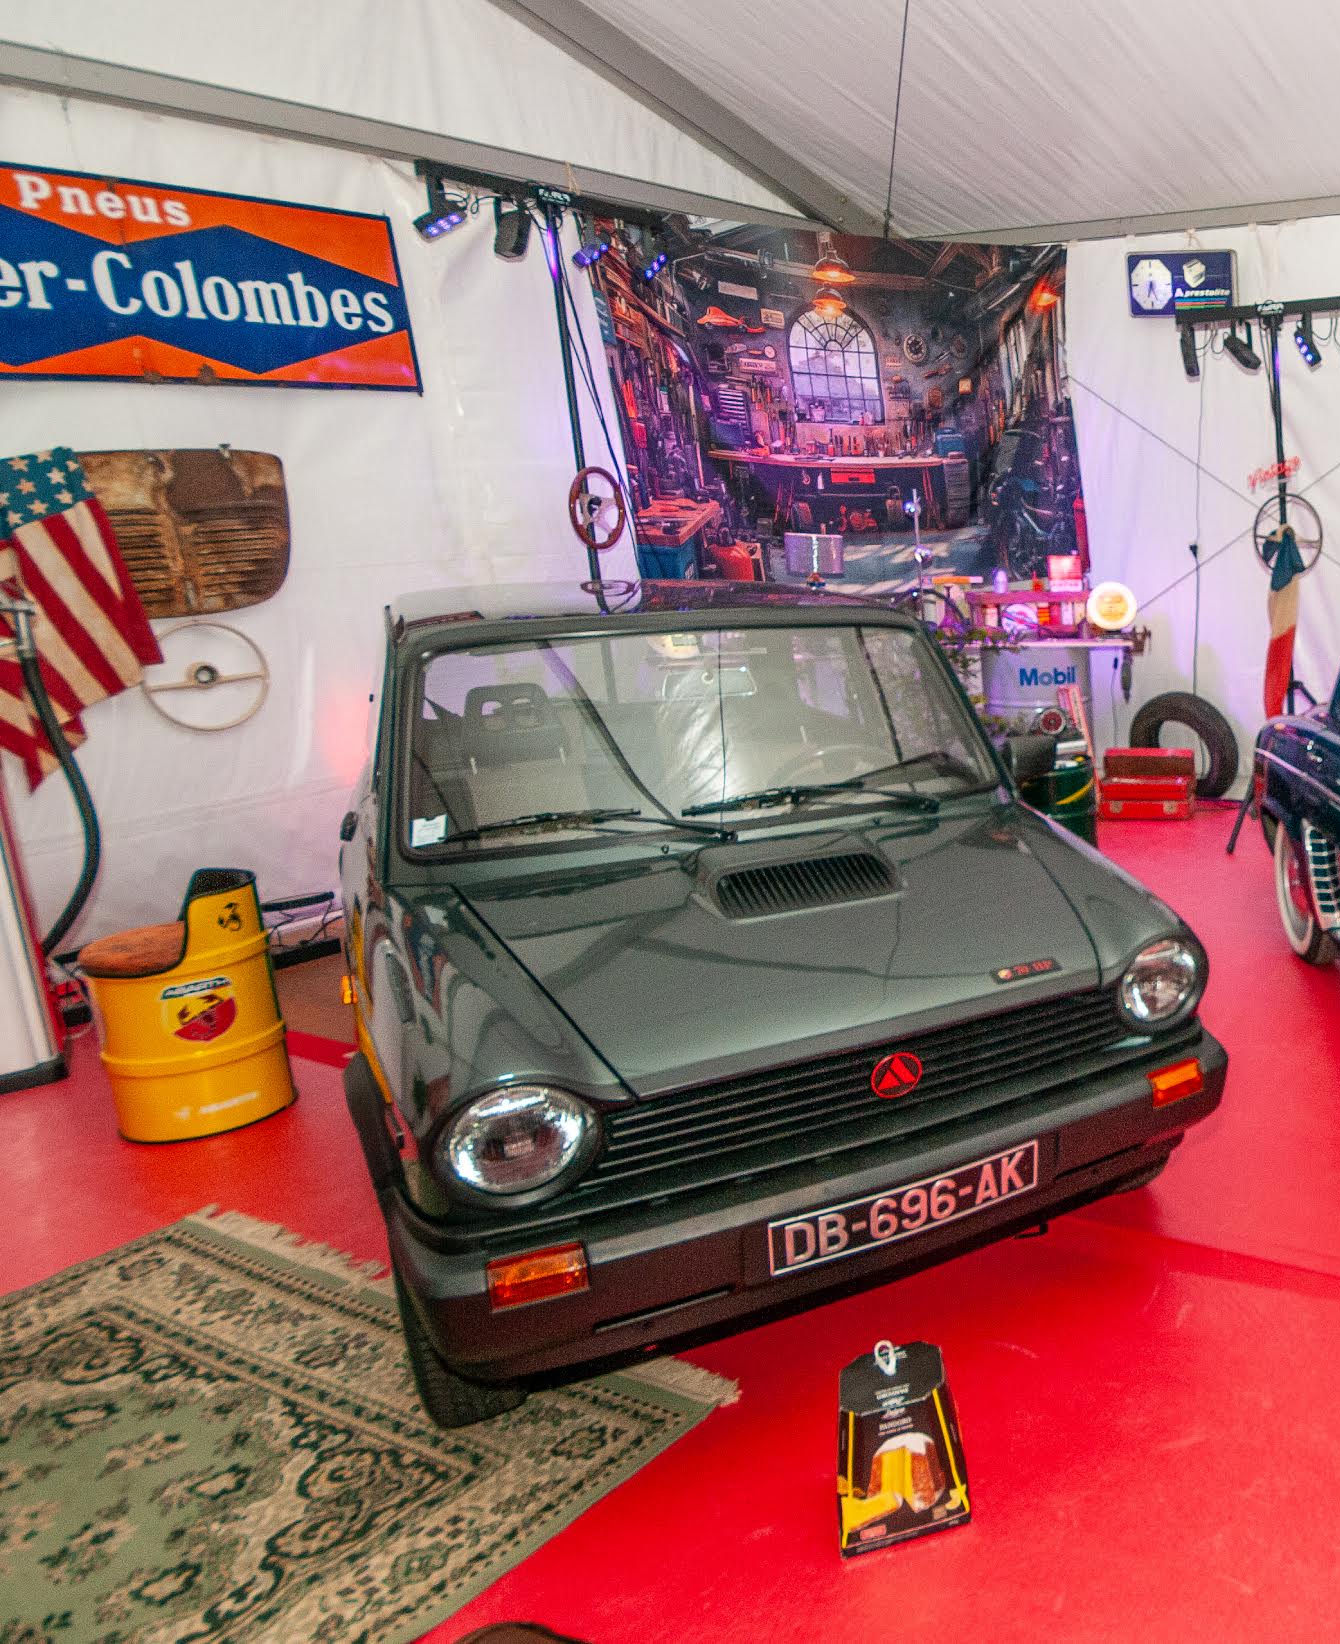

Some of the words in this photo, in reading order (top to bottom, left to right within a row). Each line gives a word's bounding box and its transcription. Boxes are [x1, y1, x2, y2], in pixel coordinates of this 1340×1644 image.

[13, 173, 192, 227] Pneus
[1019, 666, 1076, 687] Mobil
[785, 1150, 1026, 1266] DB-696-AK
